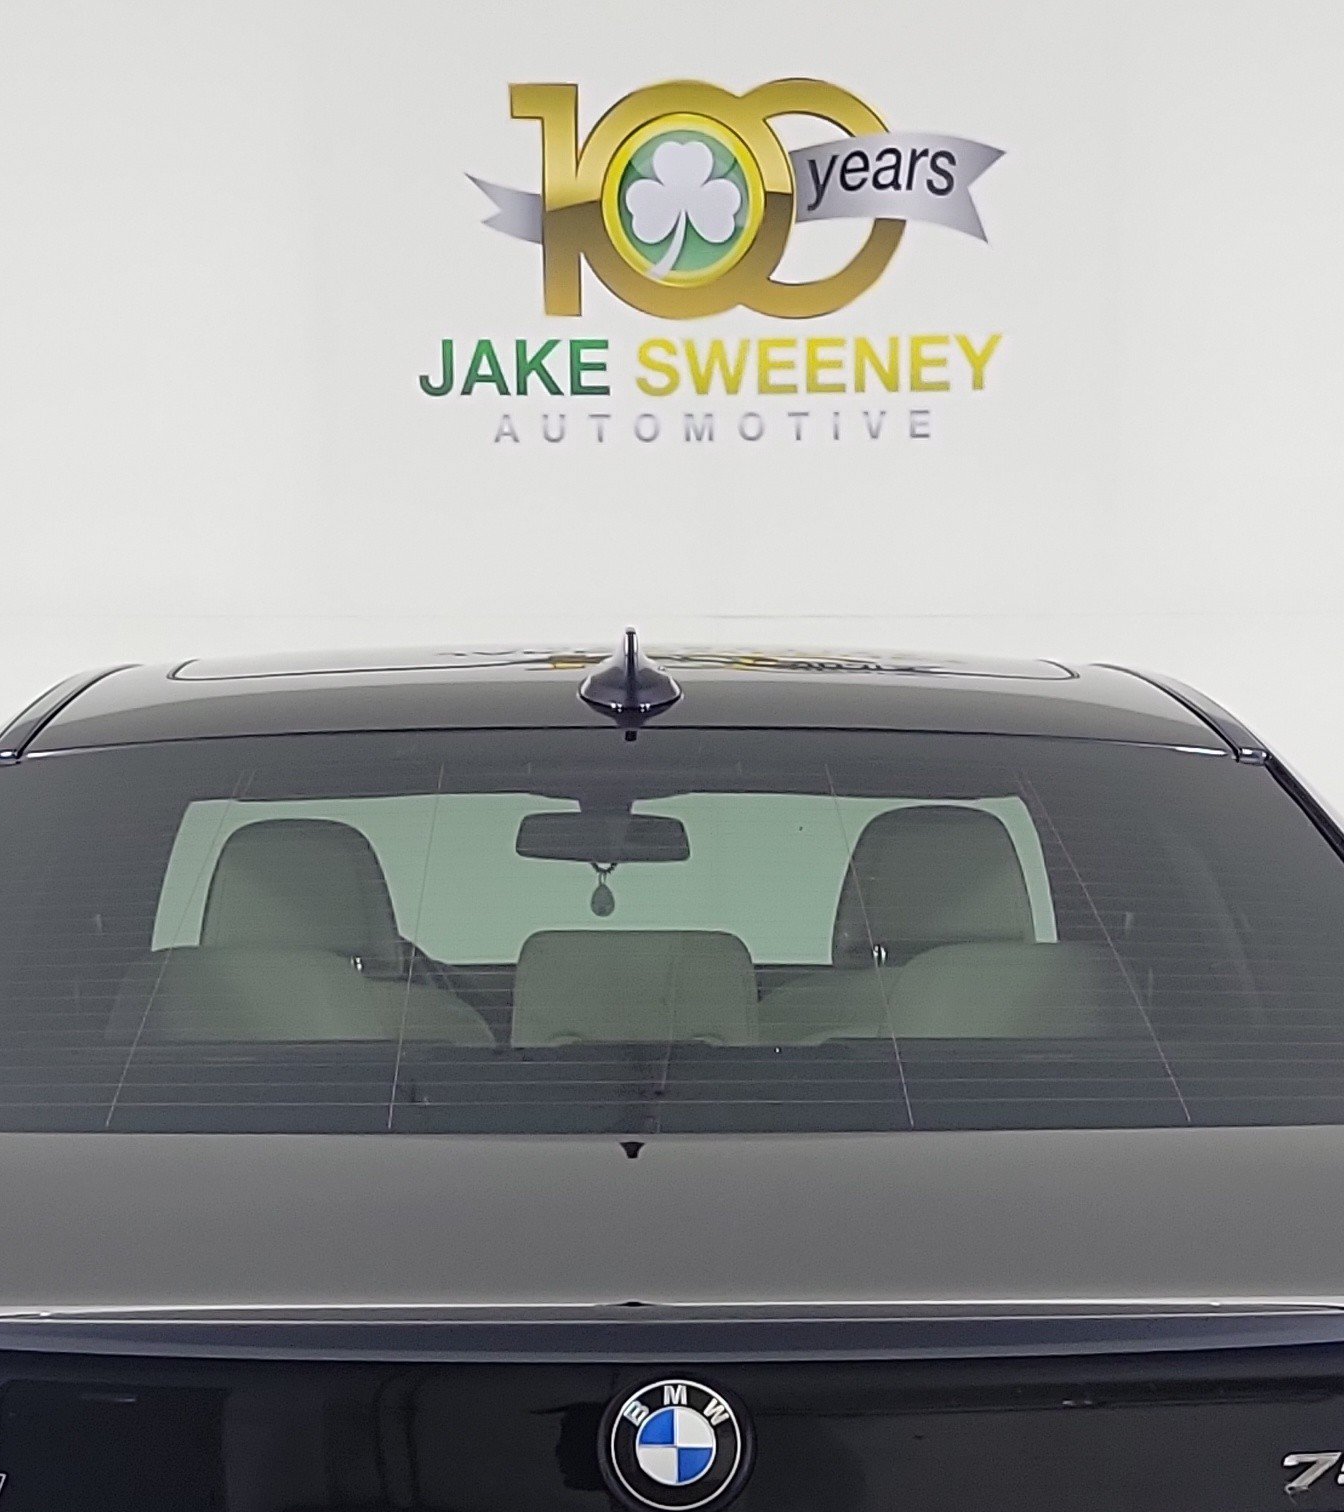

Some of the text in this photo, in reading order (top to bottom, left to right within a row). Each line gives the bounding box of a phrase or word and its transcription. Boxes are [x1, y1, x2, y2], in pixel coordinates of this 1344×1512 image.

[508, 77, 958, 320] 100 years
[418, 332, 1004, 397] JAKE SWEENEY
[493, 409, 932, 443] AUTOMOTIVE
[623, 1384, 730, 1427] BMW
